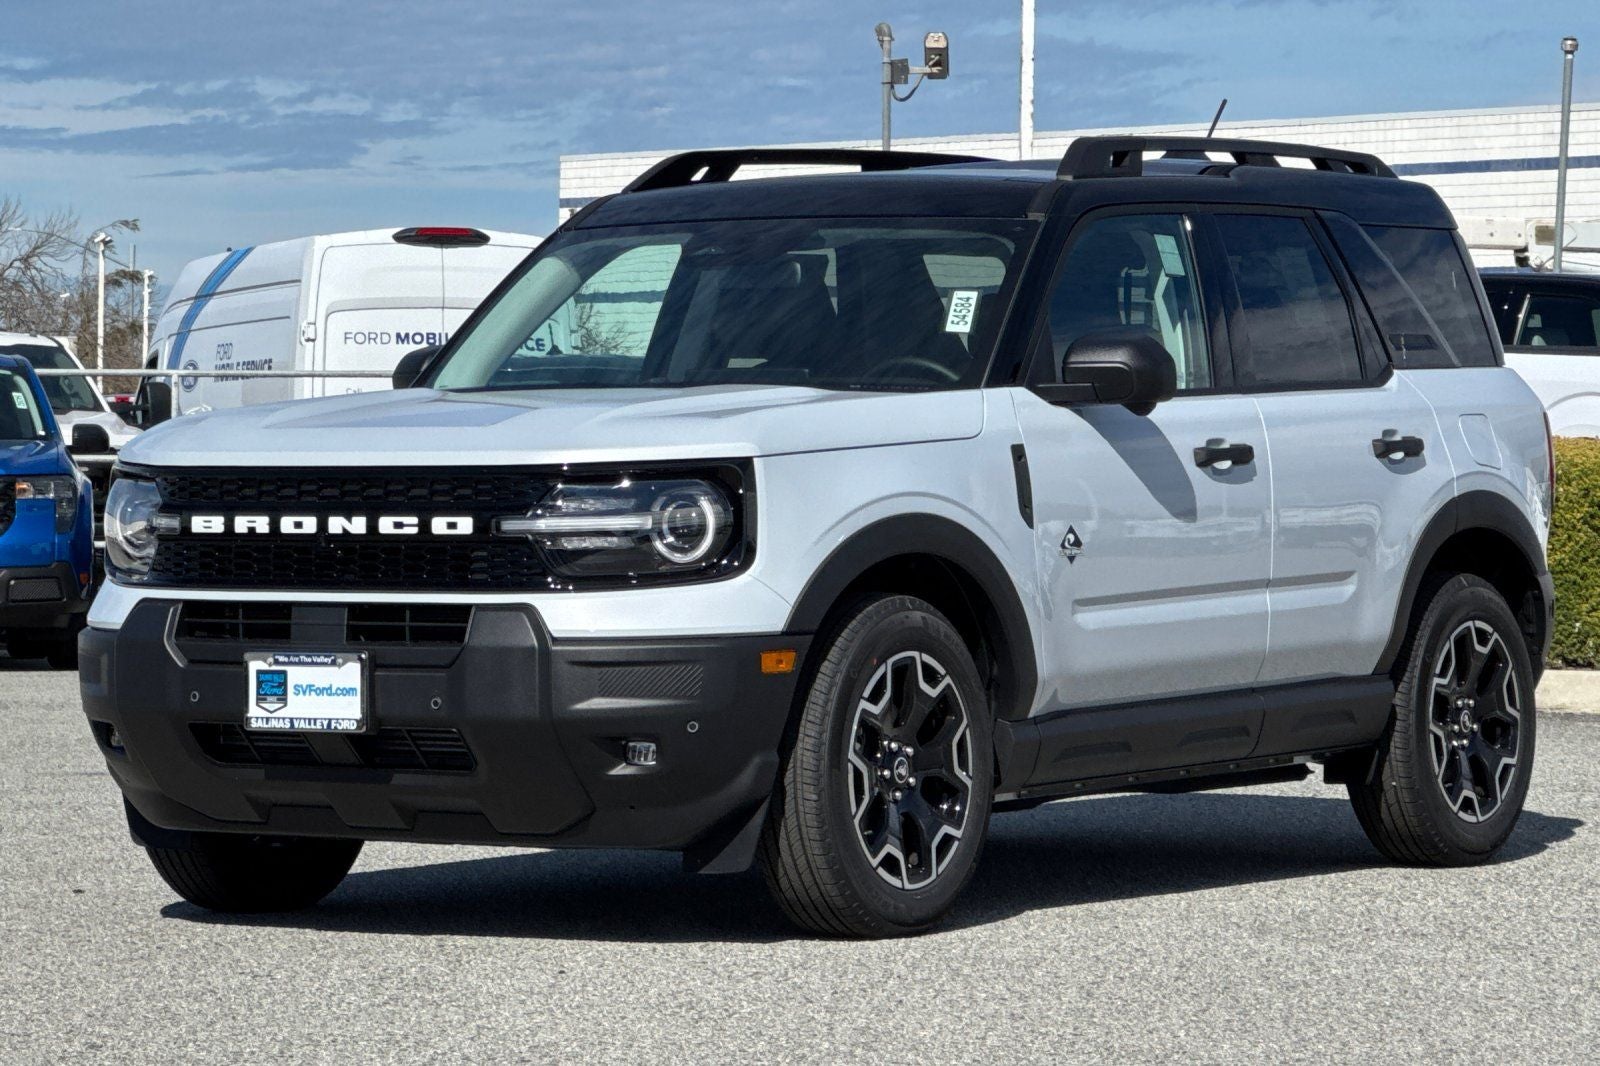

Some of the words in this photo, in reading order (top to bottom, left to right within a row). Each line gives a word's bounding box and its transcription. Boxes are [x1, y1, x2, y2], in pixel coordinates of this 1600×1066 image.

[951, 296, 974, 326] 54584
[344, 331, 391, 345] FORD
[395, 331, 450, 346] MOBIL
[216, 342, 233, 361] FORD
[191, 515, 474, 535] BRONCO
[259, 682, 285, 695] Ford
[293, 684, 358, 697] SVFord.com
[250, 717, 291, 729] SALINAS
[293, 719, 328, 729] VALLEY
[331, 719, 357, 730] FORD
